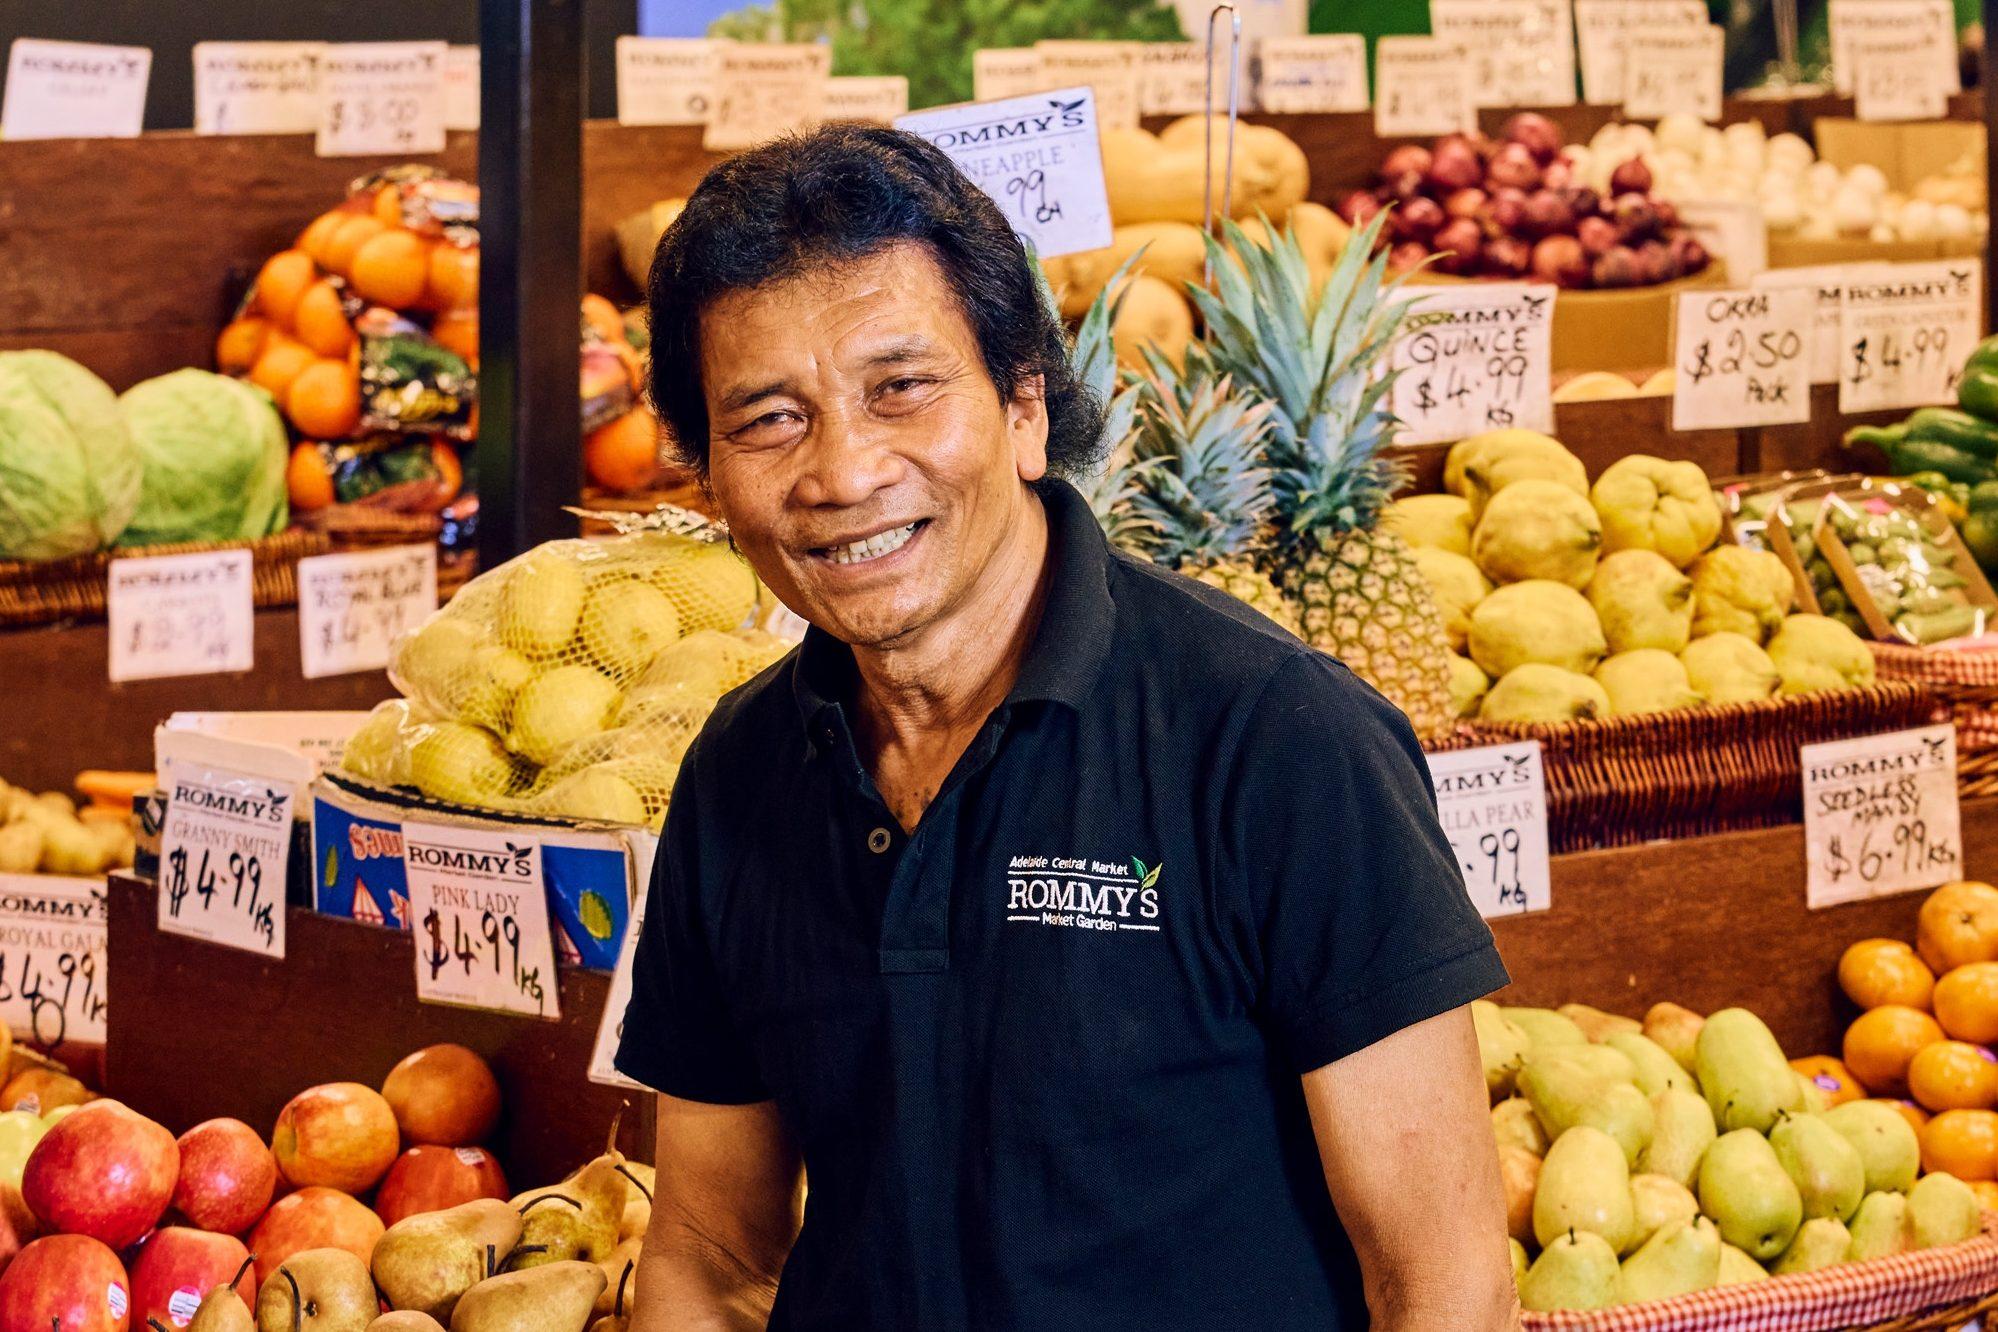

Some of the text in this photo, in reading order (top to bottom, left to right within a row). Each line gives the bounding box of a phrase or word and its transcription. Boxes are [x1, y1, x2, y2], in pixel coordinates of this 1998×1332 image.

[933, 111, 1084, 149] OMMY'S
[962, 145, 1066, 177] NEAPPLE
[1413, 354, 1528, 418] $4.99
[1436, 767, 1531, 793] MMY'S
[174, 785, 284, 823] ROMMY'S
[1444, 801, 1535, 831] LLA PEAR
[172, 820, 281, 861] GRANNY SMITH
[408, 845, 532, 877] ROMMY'S
[1009, 855, 1129, 876] Adelaide Central Market
[166, 845, 262, 918] $4.99
[0, 897, 107, 920] OMMY'
[432, 884, 520, 916] PINK LADY
[1007, 879, 1160, 919] ROMMY'S
[1042, 912, 1117, 932] Market Garden
[423, 907, 521, 986] $4.99
